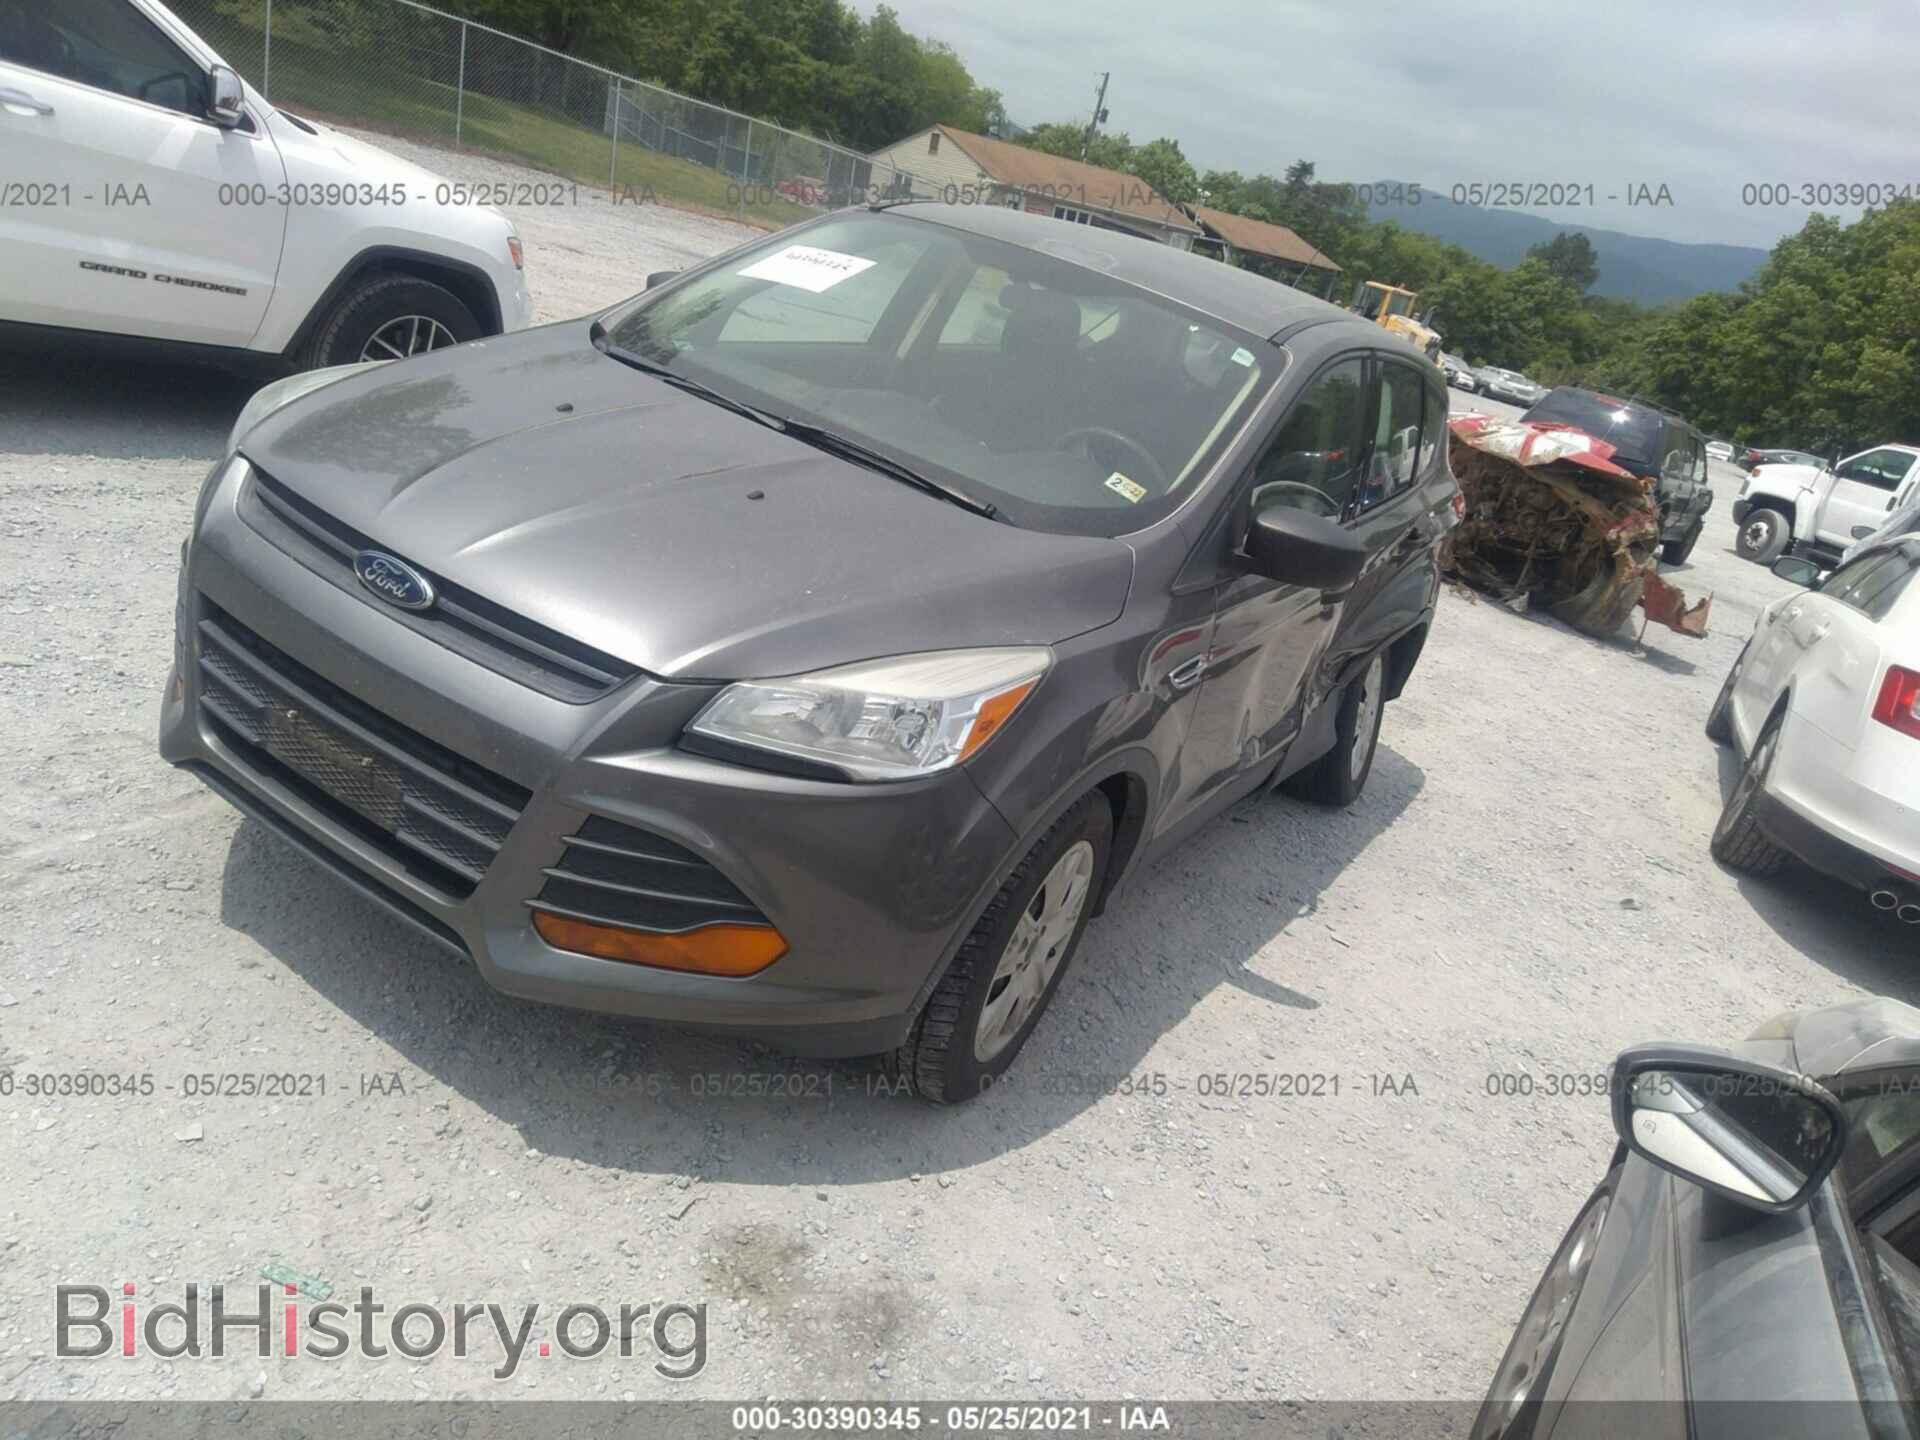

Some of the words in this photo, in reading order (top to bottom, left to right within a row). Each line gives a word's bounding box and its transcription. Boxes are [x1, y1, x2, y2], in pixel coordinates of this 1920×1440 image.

[79, 260, 147, 280] GRAND
[153, 273, 248, 296] CHEROKEE
[365, 558, 411, 598] Ford
